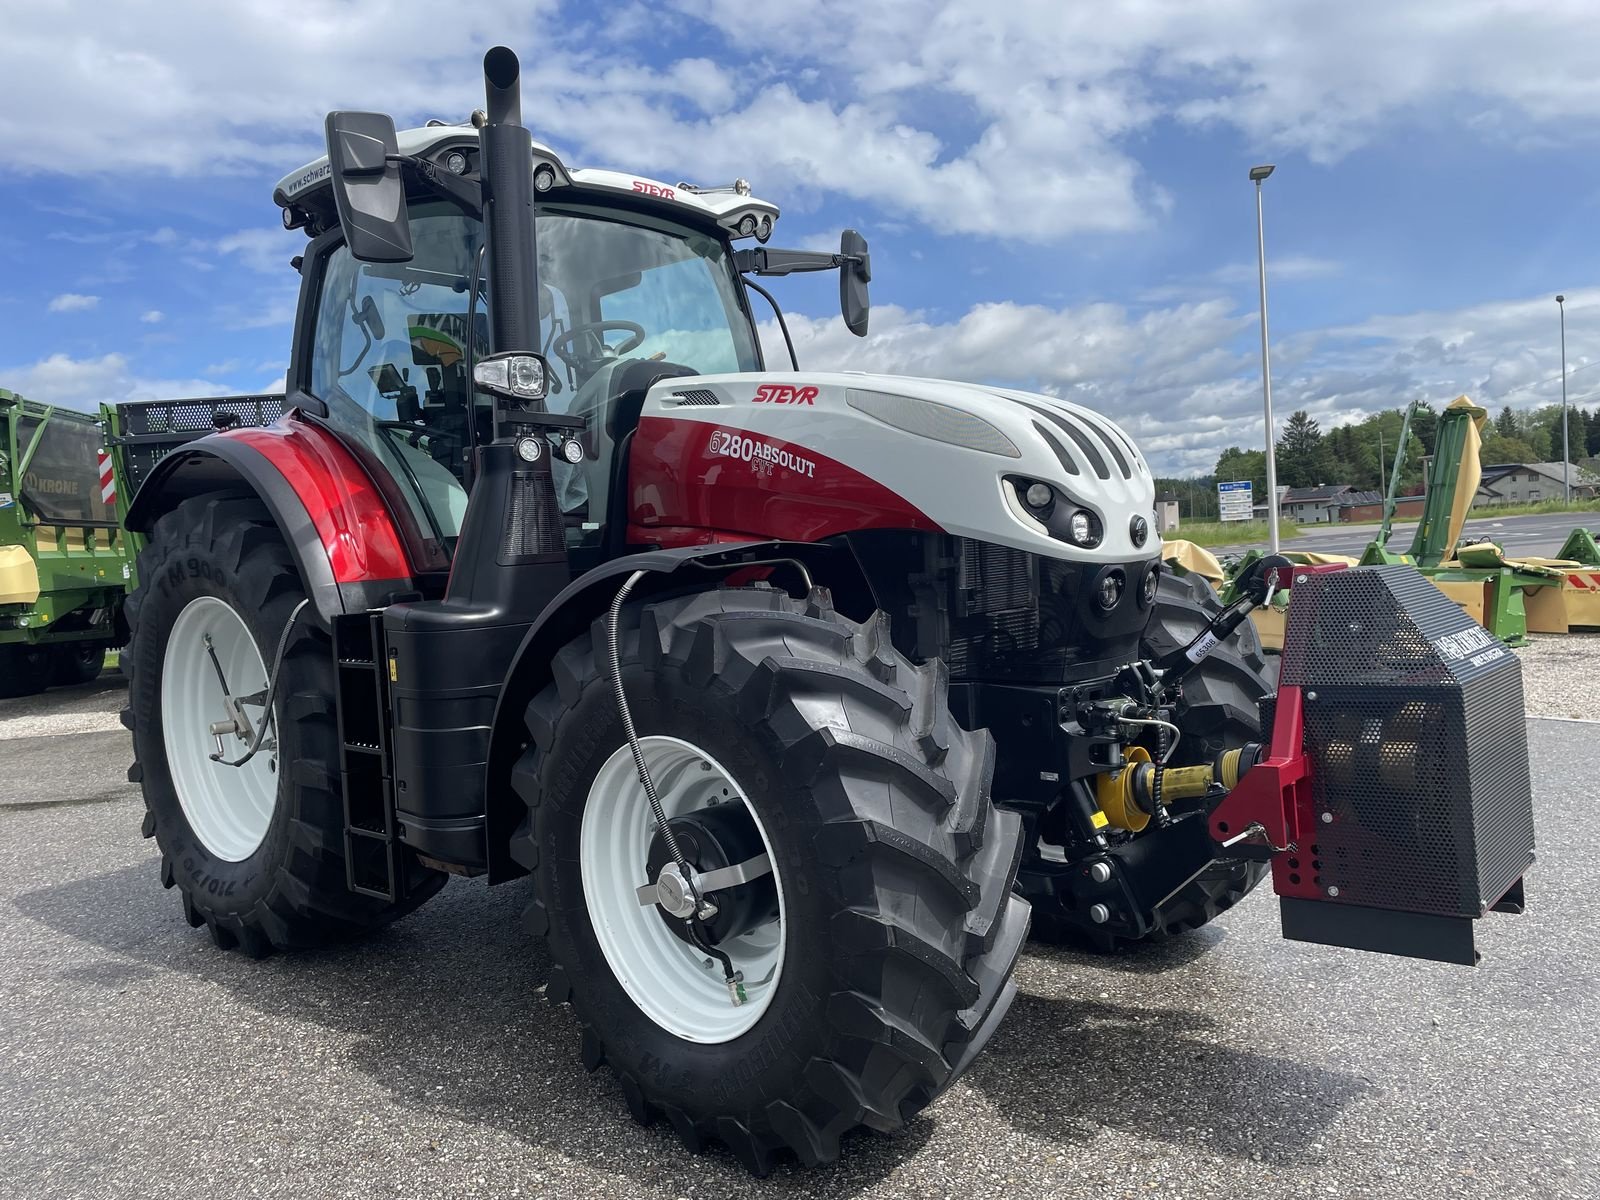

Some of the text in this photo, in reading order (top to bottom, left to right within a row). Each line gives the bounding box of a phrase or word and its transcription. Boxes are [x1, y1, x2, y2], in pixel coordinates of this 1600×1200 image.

[632, 181, 676, 201] STEYR
[752, 384, 820, 405] STEYR
[709, 430, 816, 478] 6280 ABSOLUT
[751, 456, 775, 477] CVT
[38, 478, 80, 496] KRONE
[1195, 638, 1216, 658] 65308
